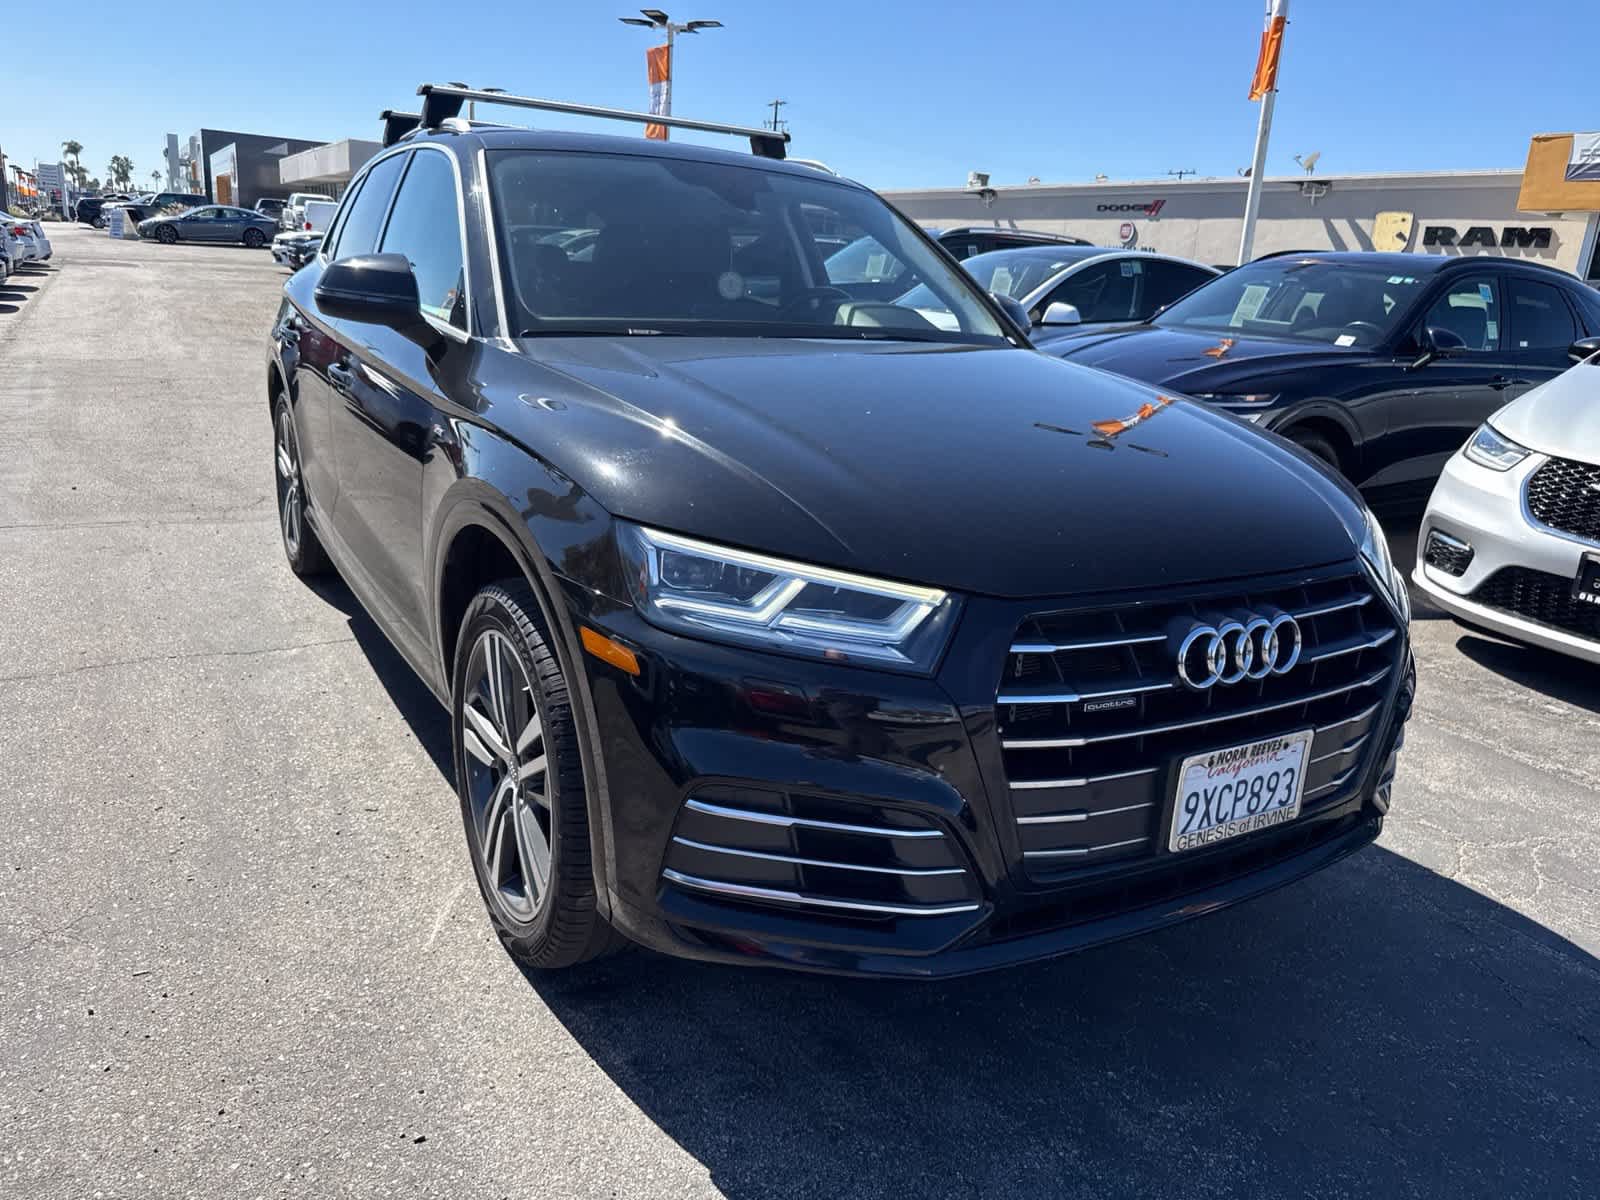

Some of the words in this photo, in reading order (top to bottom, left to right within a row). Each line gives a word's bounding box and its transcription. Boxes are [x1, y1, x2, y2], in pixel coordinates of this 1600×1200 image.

[1096, 203, 1153, 213] DODGE
[1423, 226, 1554, 249] RAM
[1086, 698, 1136, 711] quattro
[1207, 752, 1285, 780] California
[1216, 748, 1249, 766] NORM
[1250, 738, 1284, 759] REEVES
[1180, 767, 1296, 835] 9XCP893
[1177, 823, 1236, 851] GENESIS
[1238, 818, 1253, 834] of
[1253, 806, 1296, 829] IRVINE
